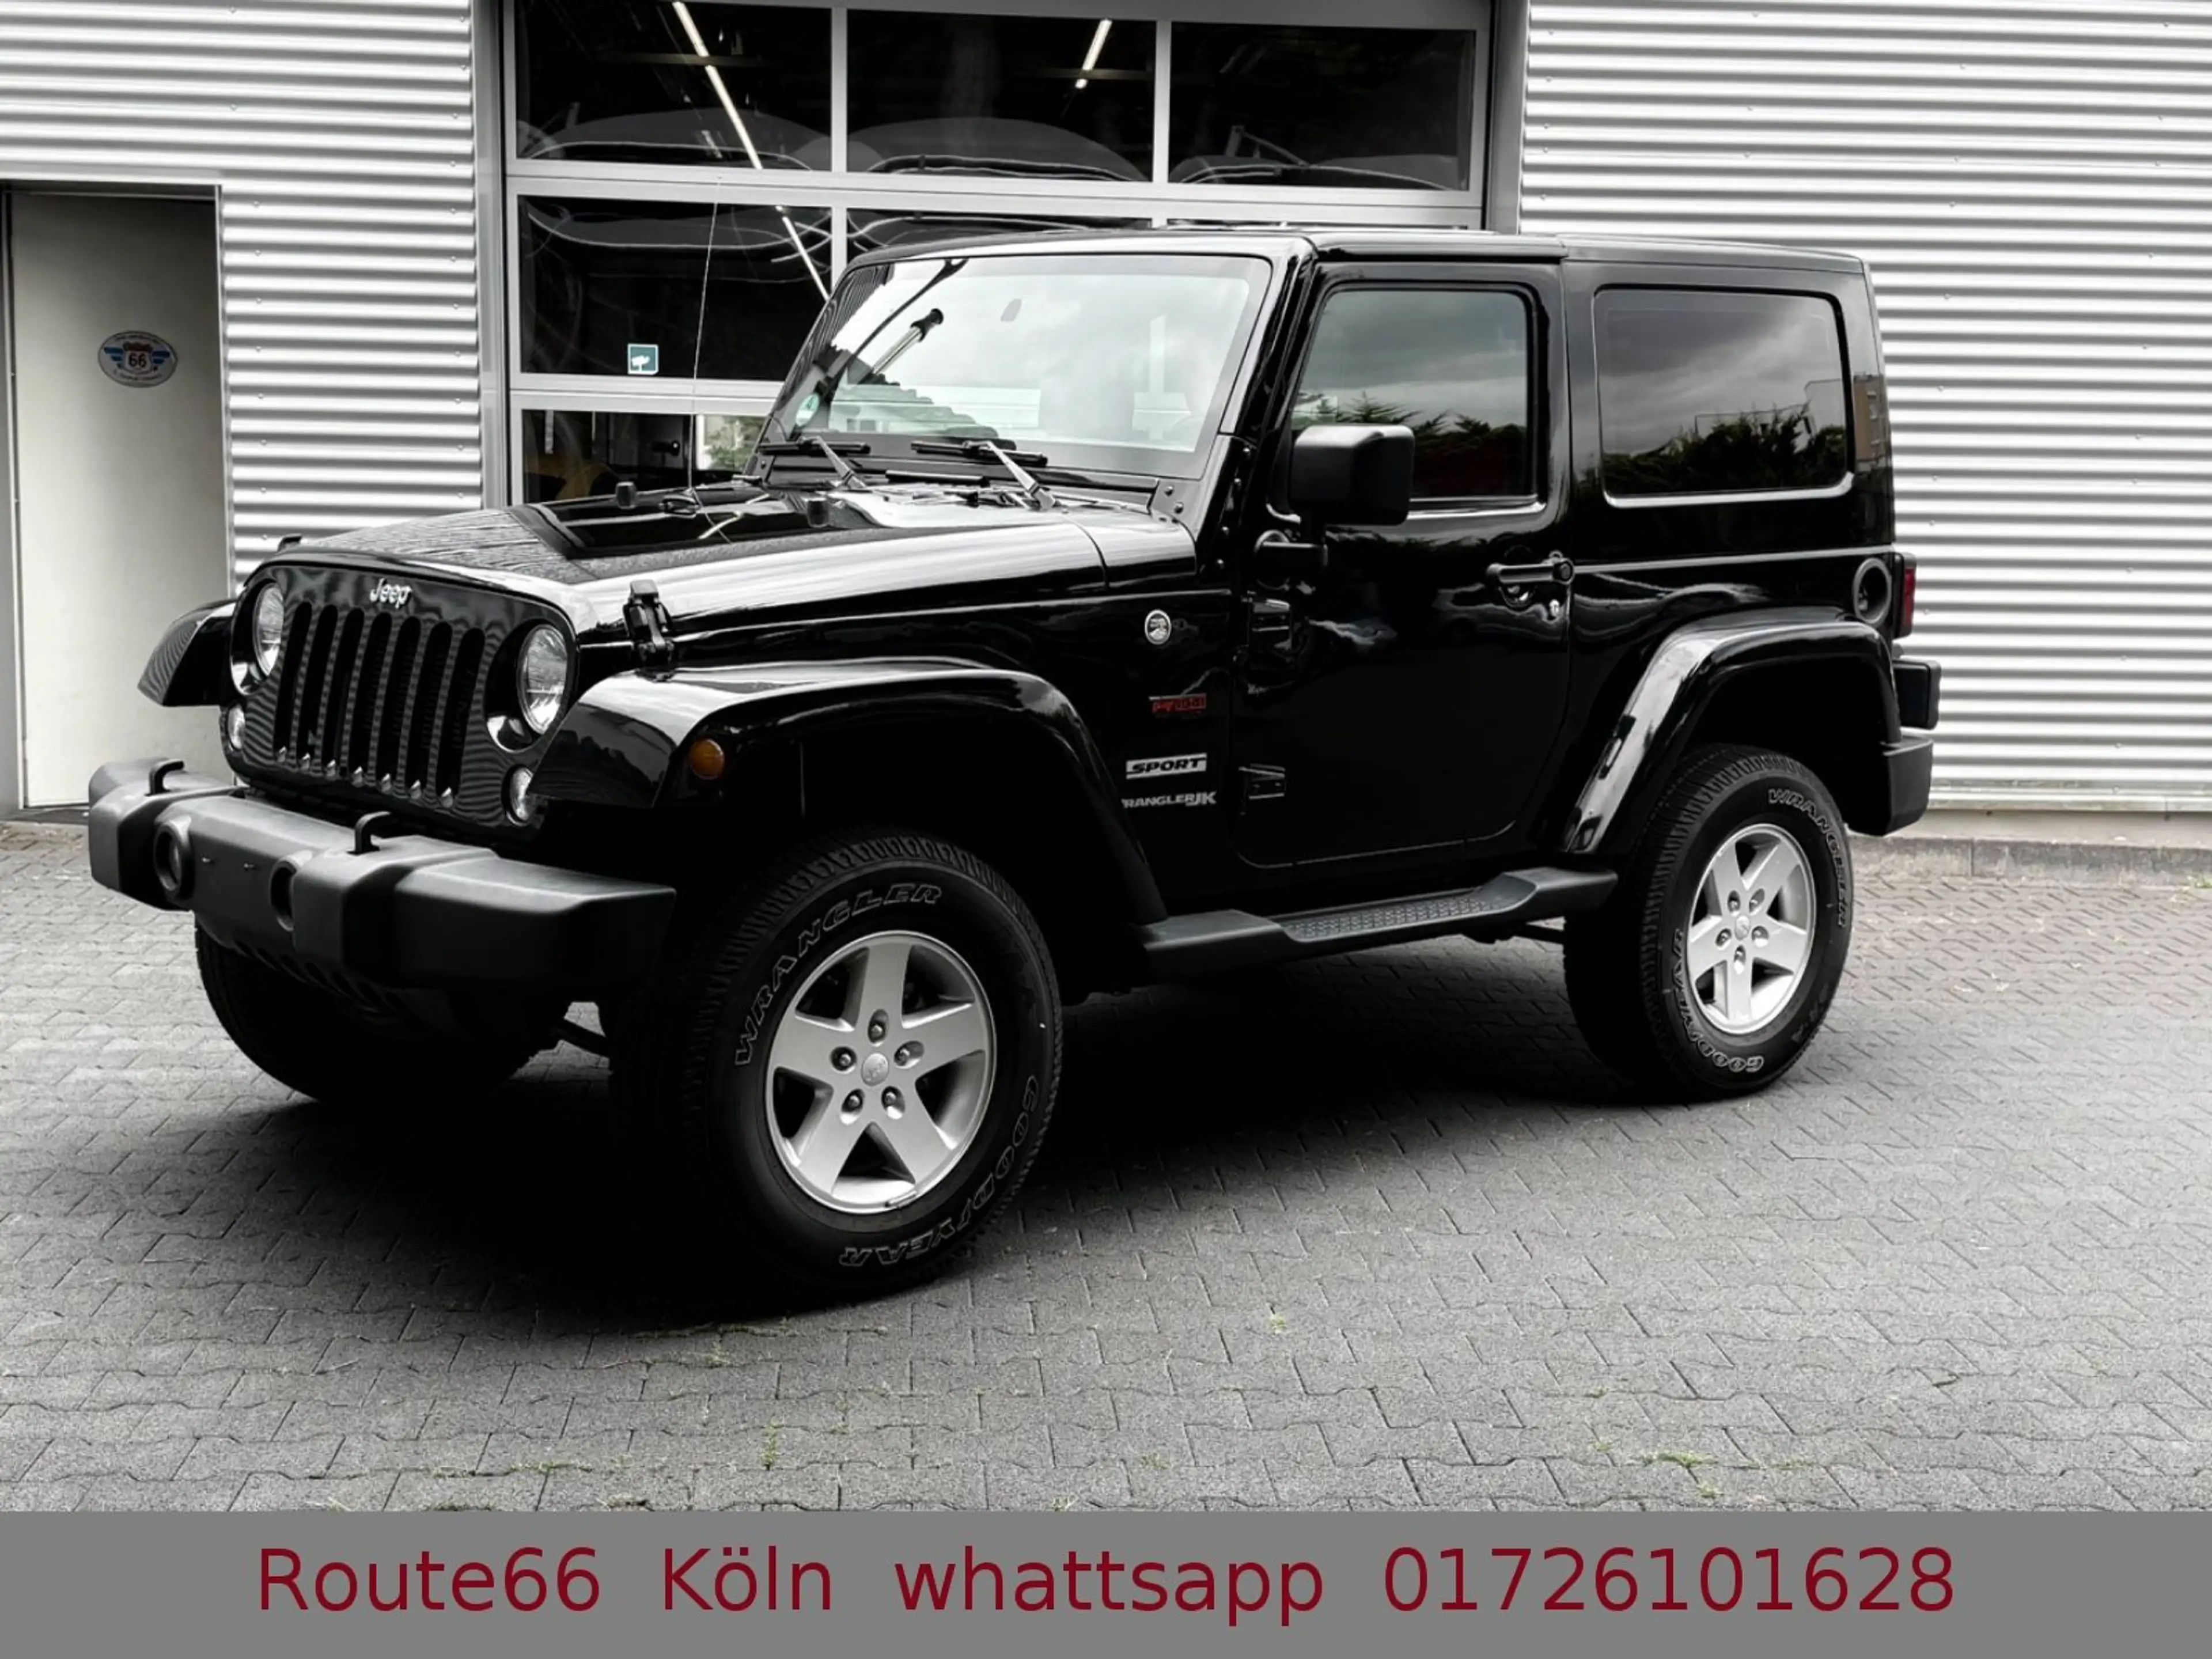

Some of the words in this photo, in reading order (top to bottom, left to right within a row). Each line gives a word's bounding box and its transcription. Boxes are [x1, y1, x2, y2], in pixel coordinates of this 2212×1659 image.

[128, 353, 147, 368] 66
[369, 577, 412, 609] Jeep
[1131, 757, 1200, 774] SPORT
[1768, 788, 1847, 927] WRANGLER
[734, 883, 942, 1066] WRANGLER
[839, 1075, 1039, 1267] GOODYEAR
